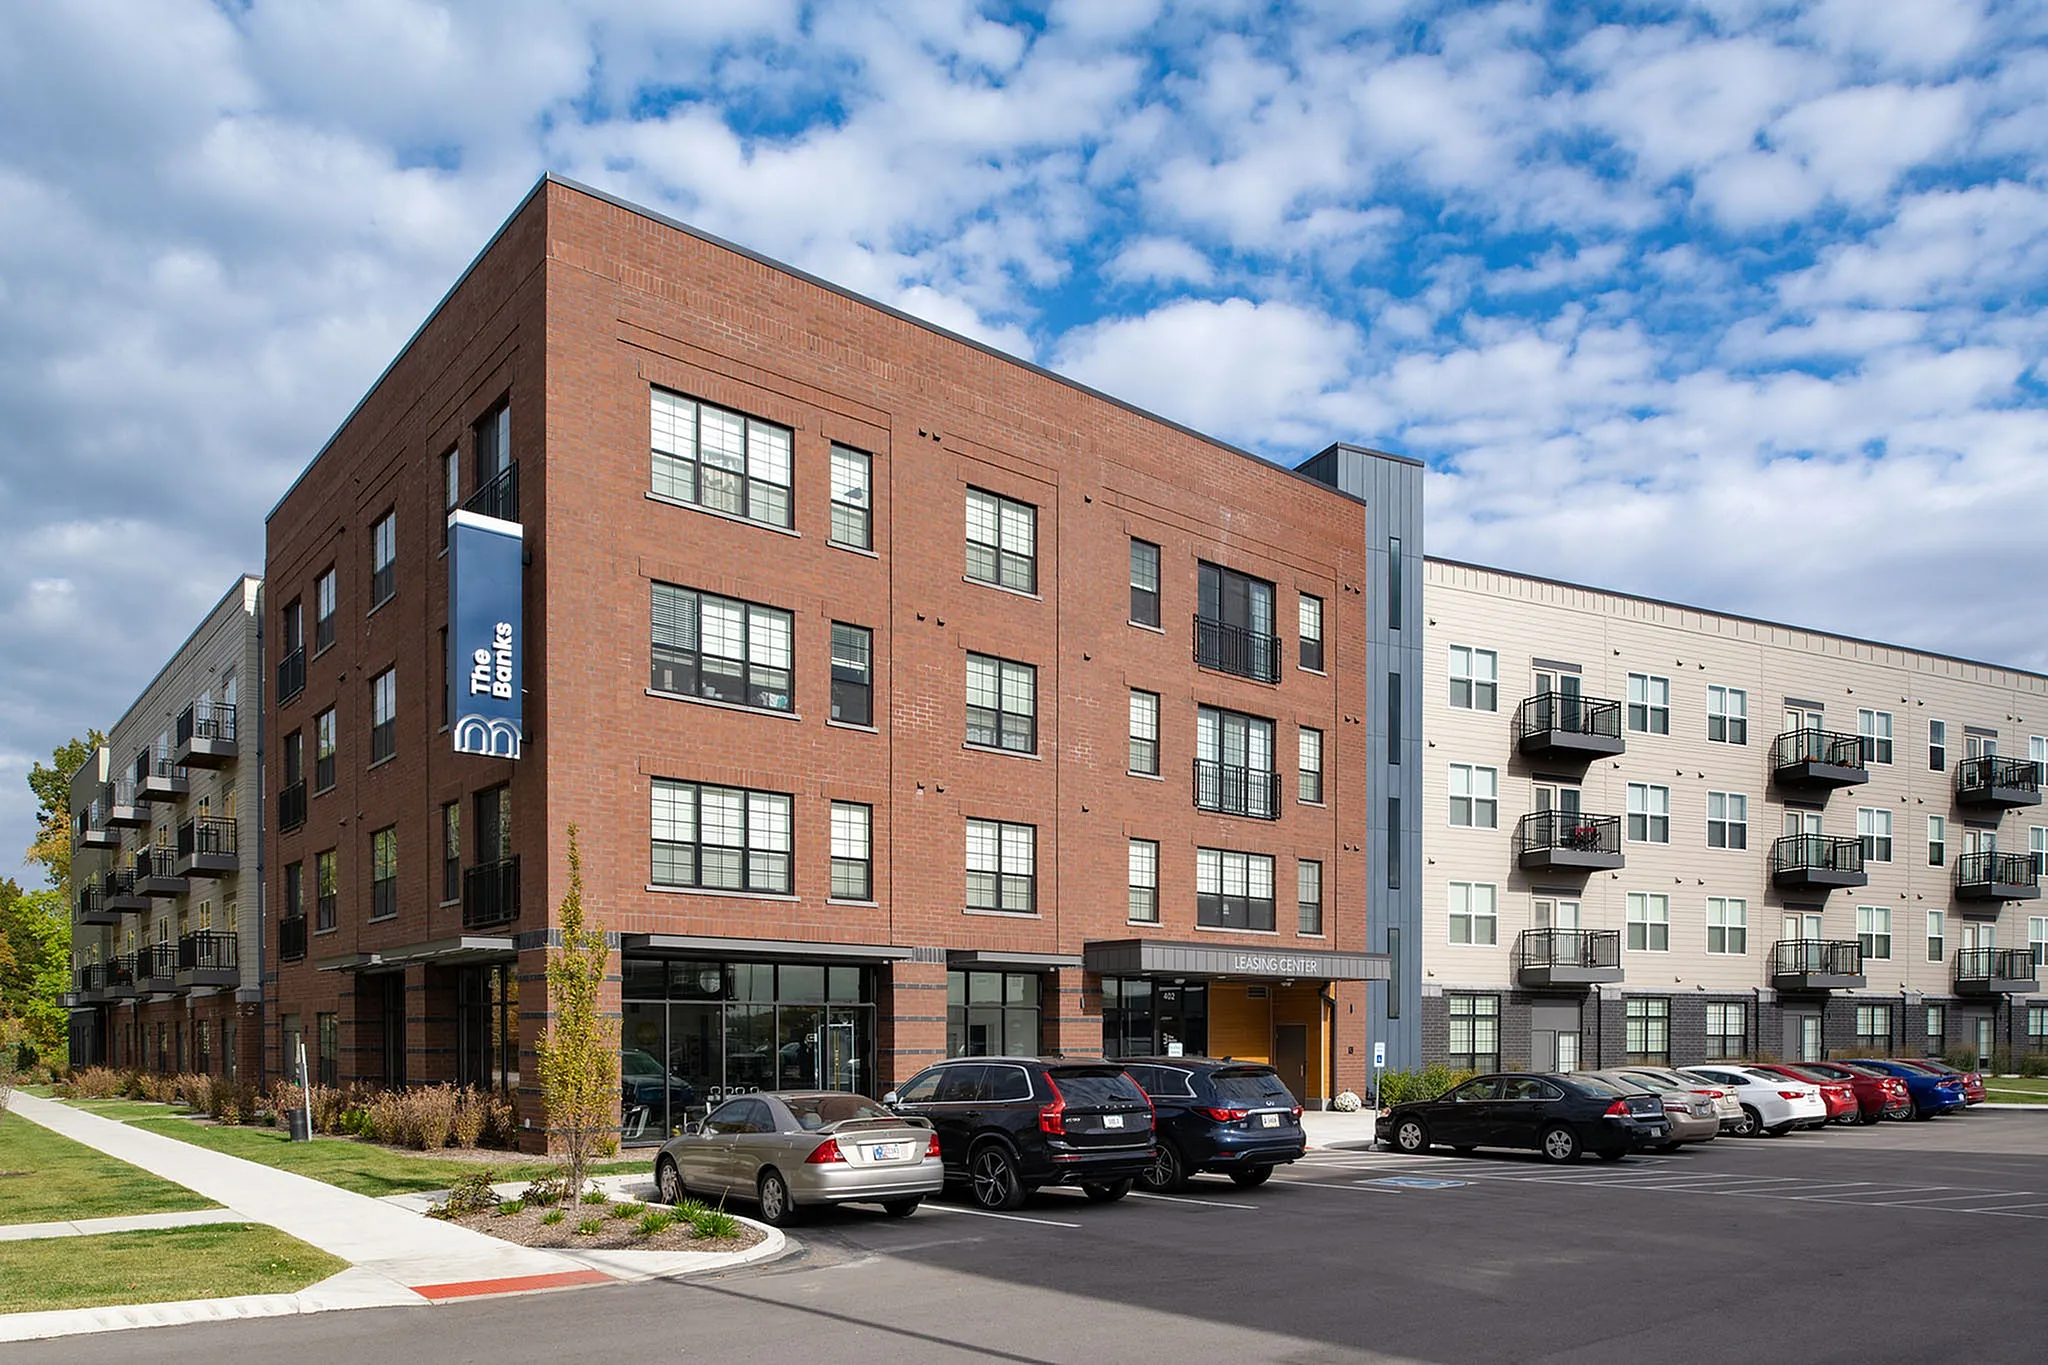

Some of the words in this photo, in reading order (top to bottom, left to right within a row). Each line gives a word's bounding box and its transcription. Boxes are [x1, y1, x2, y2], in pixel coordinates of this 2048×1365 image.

[471, 648, 491, 695] The
[492, 621, 512, 699] Banks
[1234, 956, 1278, 971] LEASING
[1279, 958, 1317, 973] CENTER
[1163, 992, 1176, 1000] 402
